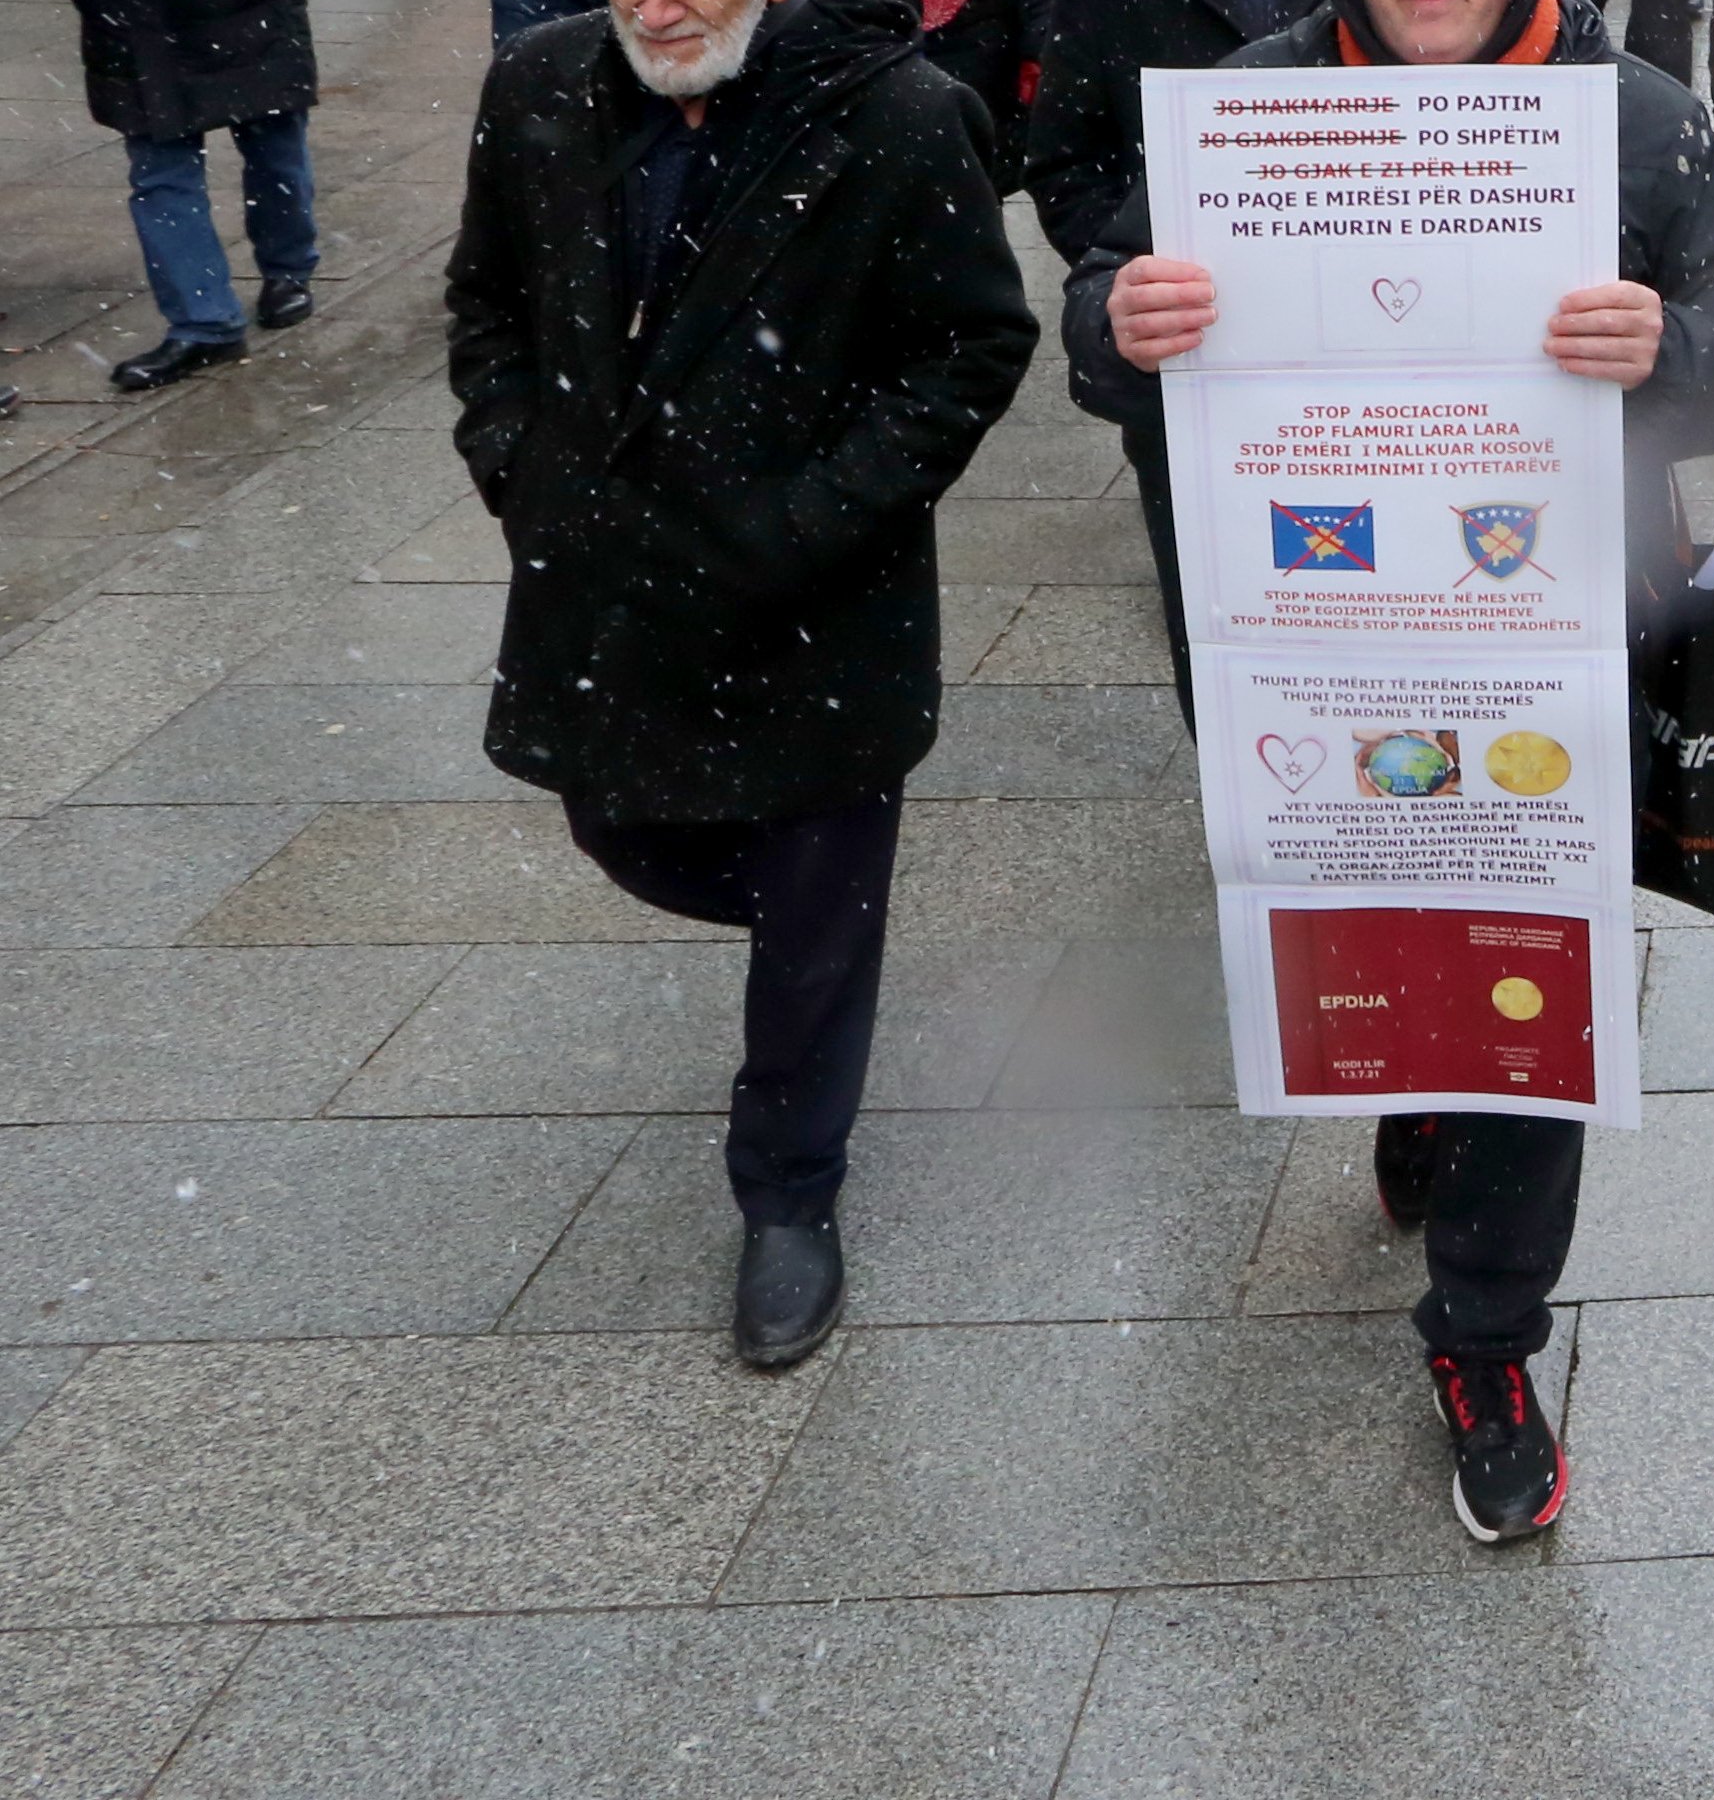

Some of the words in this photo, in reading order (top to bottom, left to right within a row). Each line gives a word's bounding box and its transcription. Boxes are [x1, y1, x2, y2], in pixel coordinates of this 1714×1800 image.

[1215, 99, 1244, 116] JO
[1252, 97, 1394, 115] HAKMARRJE
[1418, 96, 1449, 112] PO
[1457, 95, 1541, 111] PAJTIM
[1200, 133, 1226, 148] JO
[1236, 129, 1401, 148] GJAKDERDHJE
[1419, 129, 1449, 145] PO
[1457, 125, 1560, 145] SHPËTIM
[1258, 164, 1286, 180] JO
[1294, 162, 1352, 179] GJAK
[1361, 163, 1372, 178] E
[1380, 162, 1404, 178] ZI
[1412, 157, 1455, 177] PËR
[1463, 161, 1513, 176] LIRI
[1199, 193, 1229, 208] PO
[1238, 192, 1297, 211] PAQE
[1306, 192, 1318, 207] E
[1326, 186, 1410, 206] MIRËSI
[1419, 185, 1461, 205] PËR
[1470, 188, 1575, 204] DASHURI
[1232, 221, 1263, 237] ME
[1272, 219, 1391, 236] FLAMURIN
[1402, 219, 1412, 234] E
[1421, 217, 1542, 234] DARDANIS
[1303, 406, 1350, 419] STOP
[1362, 404, 1488, 419] ASOCIACIONI
[1278, 425, 1325, 438] STOP
[1332, 425, 1414, 438] FLAMURI
[1421, 424, 1467, 437] LARA
[1473, 423, 1520, 436] LARA
[1240, 443, 1286, 456] STOP
[1293, 441, 1351, 457] EMËRI
[1363, 444, 1370, 457] I
[1377, 443, 1475, 456] MALLKUAR
[1482, 438, 1554, 454] KOSOVË
[1234, 462, 1280, 475] STOP
[1287, 463, 1424, 476] DISKRIMINIMI
[1431, 462, 1438, 475] I
[1444, 457, 1560, 477] QYTETARËVE
[1264, 591, 1300, 601] STOP
[1454, 592, 1473, 603] NË
[1478, 594, 1506, 602] MES
[1510, 593, 1543, 602] VETI
[1275, 605, 1310, 614] STOP
[1315, 606, 1385, 616] EGOIZMIT
[1390, 607, 1425, 617] STOP
[1430, 608, 1533, 617] MASHTRIMEVE
[1231, 616, 1266, 625] STOP
[1271, 617, 1359, 629] INJORANCËS
[1363, 620, 1399, 630] STOP
[1404, 621, 1463, 631] PABESIS
[1468, 622, 1496, 631] DHE
[1501, 620, 1581, 631] TRADHËTIS
[1251, 675, 1298, 687] THUNI
[1304, 677, 1323, 687] PO
[1329, 677, 1385, 689] EMËRIT
[1390, 678, 1407, 690] TË
[1412, 679, 1488, 691] PERËNDIS
[1493, 681, 1563, 691] DARDANI
[1282, 691, 1329, 702] THUNI
[1335, 693, 1354, 703] PO
[1359, 694, 1435, 705] FLAMURIT
[1441, 695, 1471, 705] DHE
[1475, 694, 1533, 706] STEMËS
[1310, 705, 1326, 717] SË
[1332, 707, 1411, 718] DARDANIS
[1420, 708, 1437, 719] TË
[1443, 709, 1506, 720] MIRËSIS
[1285, 803, 1310, 811] VET
[1315, 803, 1401, 811] VENDOSUNI
[1411, 802, 1464, 811] BESONI
[1470, 801, 1487, 810] SE
[1492, 802, 1513, 810] ME
[1517, 800, 1569, 810] MIRËSI
[1268, 814, 1360, 824] MITROVICËN
[1365, 815, 1385, 823] DO
[1390, 815, 1407, 823] TA
[1413, 813, 1498, 823] BASHKOJMË
[1504, 814, 1525, 822] ME
[1529, 813, 1584, 824] EMËRIN
[1336, 826, 1388, 836] MIRËSI
[1394, 827, 1413, 835] DO
[1419, 826, 1436, 835] TA
[1441, 824, 1518, 834] EMËROJMË
[1320, 994, 1389, 1009] EPDIJA
[1333, 1061, 1361, 1069] KODI
